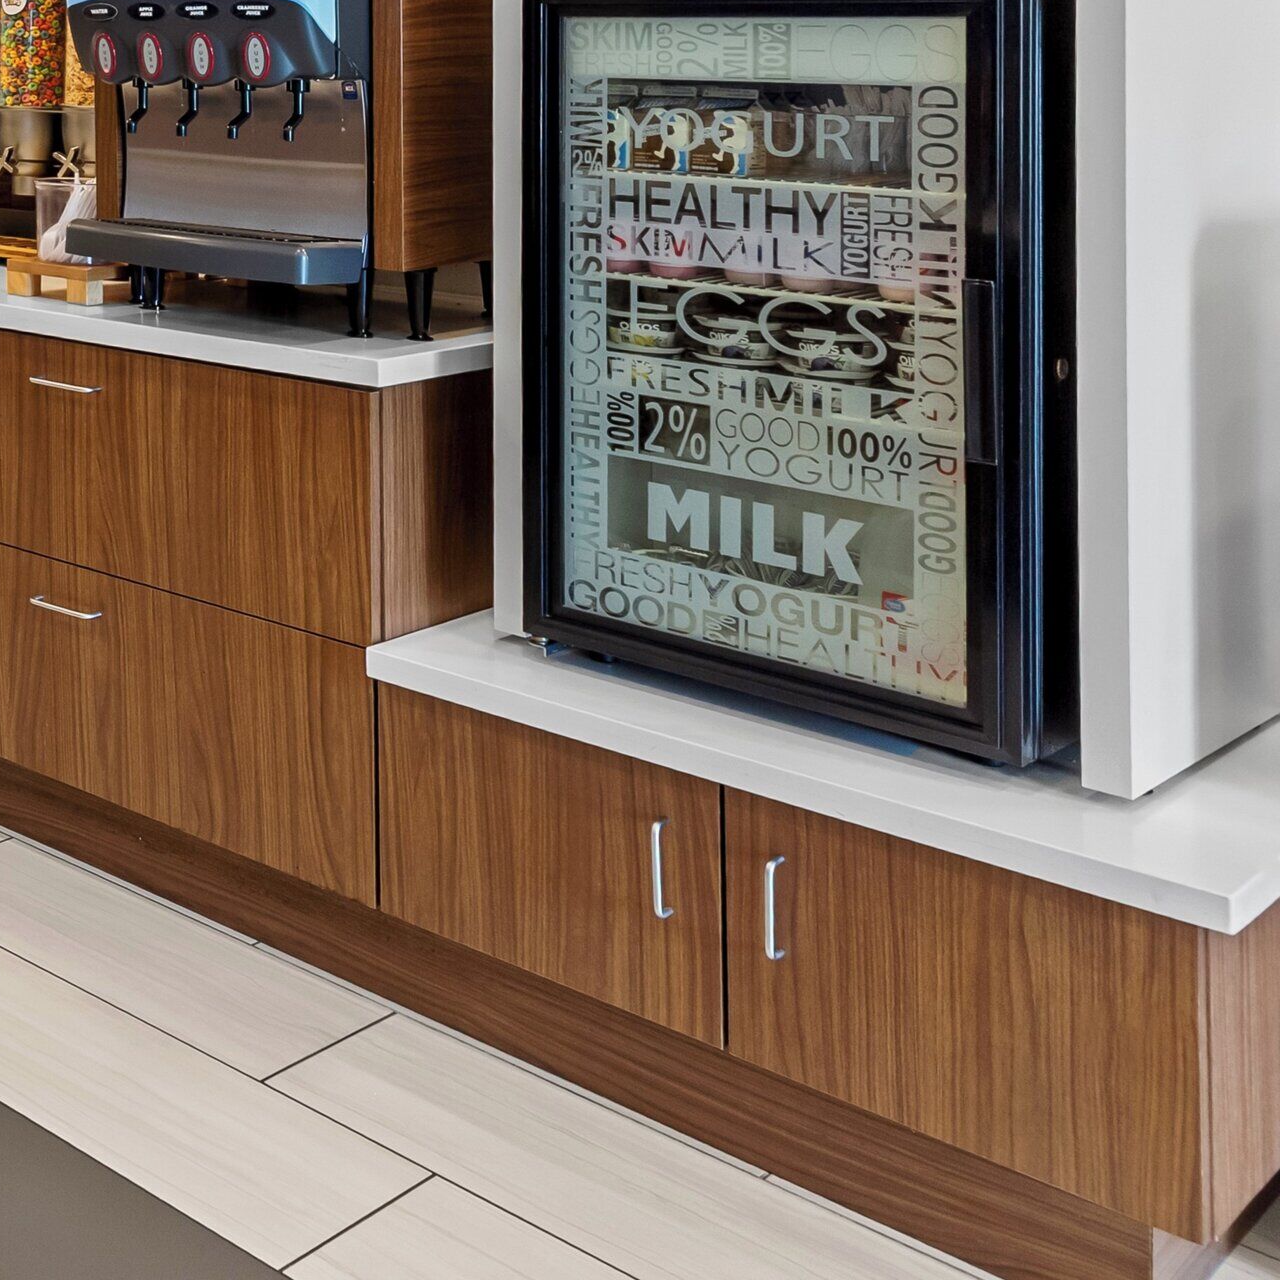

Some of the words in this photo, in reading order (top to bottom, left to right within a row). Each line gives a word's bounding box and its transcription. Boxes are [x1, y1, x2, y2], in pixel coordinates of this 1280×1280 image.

[571, 22, 653, 51] SKIM
[655, 23, 673, 76] GOOD
[676, 23, 719, 76] 2%
[723, 23, 748, 79] MILK
[758, 23, 788, 77] 100%
[796, 24, 959, 82] EGGS
[618, 106, 895, 162] YOGURT
[918, 85, 959, 193] GOOD
[609, 178, 838, 236] HEALTHY
[843, 193, 870, 276] YOGURT
[606, 224, 694, 260] SKIM
[698, 232, 836, 275] MILK
[630, 279, 888, 367] EGGS
[607, 356, 747, 404] FRESH
[755, 376, 914, 425] MILK
[607, 391, 635, 452] 100%
[644, 401, 707, 461] 2%
[715, 408, 820, 452] GOOD
[826, 425, 912, 469] 100%
[718, 440, 910, 502] YOGURT
[647, 481, 865, 586] MILK
[918, 491, 957, 575] GOOD
[569, 579, 697, 635] GOOD
